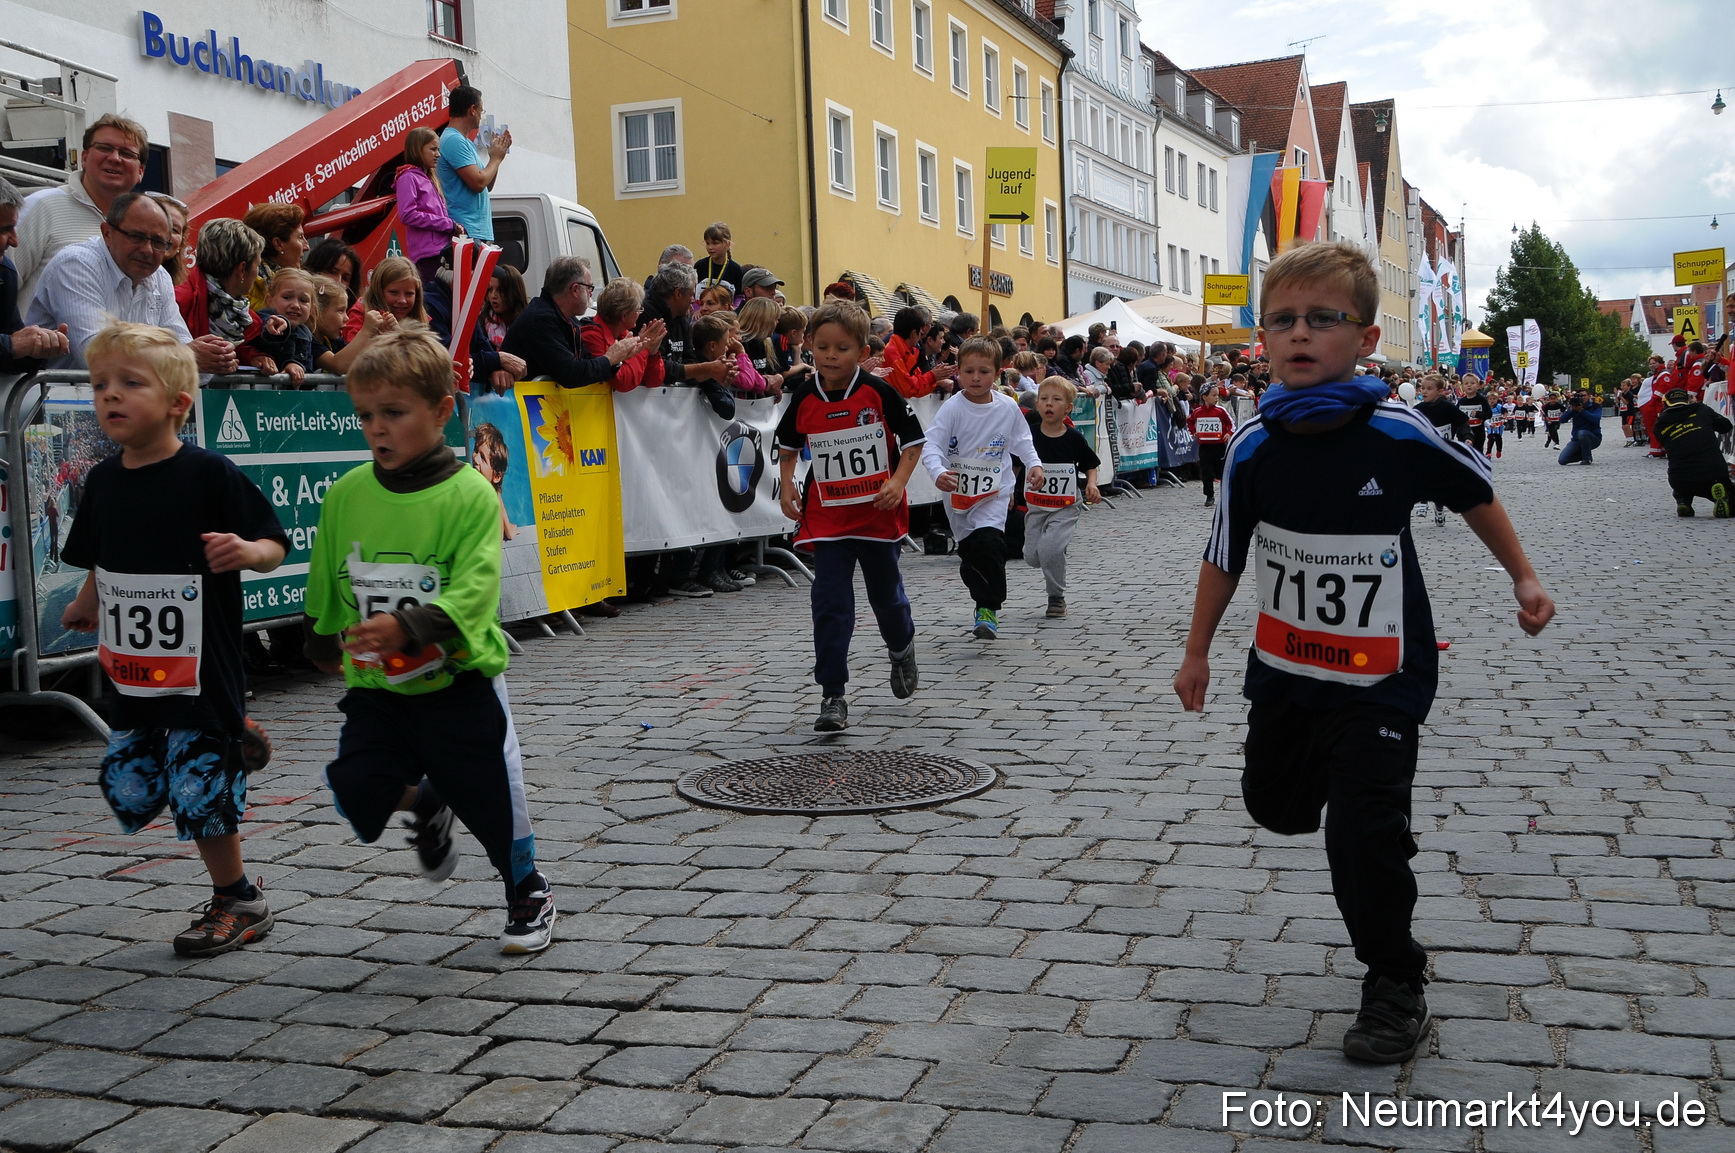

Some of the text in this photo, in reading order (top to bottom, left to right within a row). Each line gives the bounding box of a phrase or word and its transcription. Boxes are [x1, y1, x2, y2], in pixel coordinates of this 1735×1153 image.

[138, 11, 362, 109] Buchhandlun
[268, 182, 302, 204] Miet-
[304, 173, 315, 191] &
[380, 110, 411, 141] 09181
[411, 94, 437, 123] 6352
[988, 168, 1035, 182] Jugend-
[1000, 183, 1022, 194] lauf
[1677, 259, 1721, 269] Schnupper-
[1692, 268, 1706, 276] lauf
[1207, 283, 1245, 291] Schnupper-
[1676, 307, 1698, 316] Block
[1681, 318, 1695, 335] A
[256, 411, 363, 435] Event-Leit-Syste
[1200, 424, 1219, 432] 7243
[810, 432, 873, 449] PARTL Neumarkt
[818, 444, 879, 479] 7161
[964, 464, 991, 473] Neumarkt
[271, 472, 338, 507] & Acti
[1038, 477, 1069, 494] 287
[1358, 487, 1383, 496] adidas
[539, 492, 563, 504] Pflaster
[541, 507, 586, 522] Außenplatten
[543, 525, 574, 540] Palisaden
[546, 545, 567, 557] Stufen
[1257, 534, 1373, 566] PARTL Neumarkt
[548, 558, 596, 575] Gartenmauern
[111, 585, 176, 600] Neumarkt
[243, 584, 308, 610] iet & Ser
[1266, 559, 1382, 628] 7137
[1387, 624, 1396, 633] M
[1285, 632, 1350, 666] Simon
[113, 659, 150, 681] Felix
